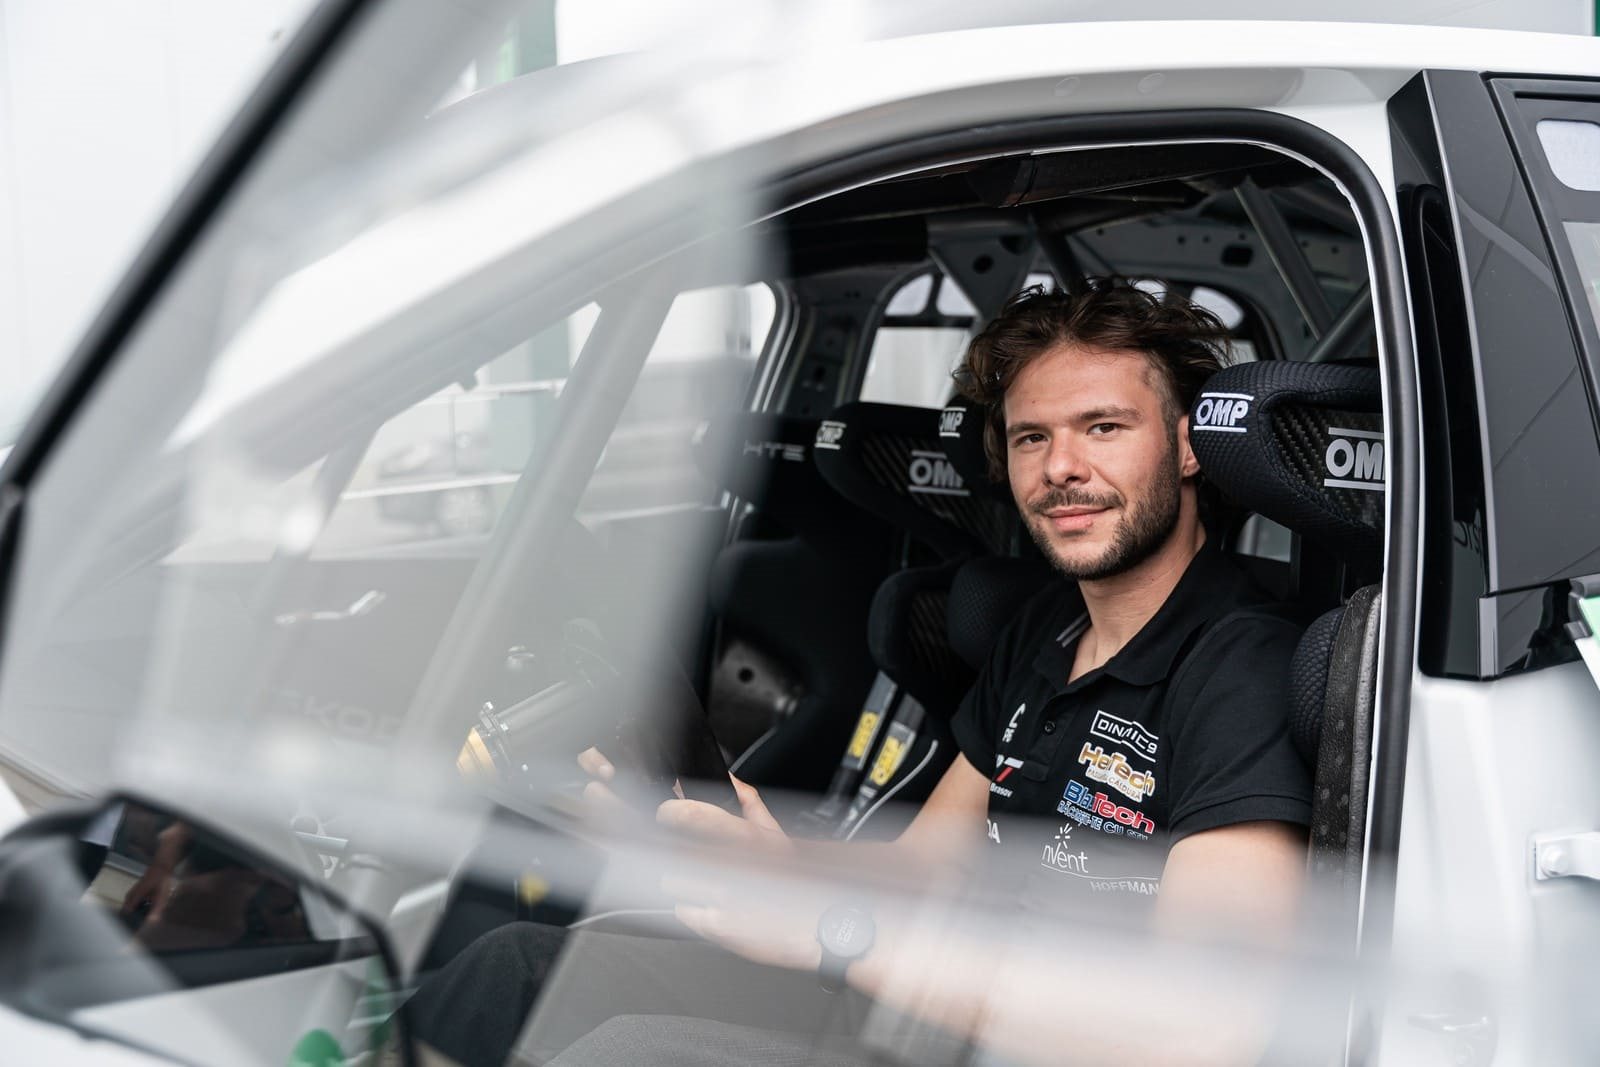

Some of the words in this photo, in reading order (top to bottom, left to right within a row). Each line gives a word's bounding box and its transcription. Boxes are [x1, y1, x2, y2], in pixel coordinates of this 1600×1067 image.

[1195, 399, 1249, 426] OMP
[1325, 439, 1385, 480] OM
[1090, 880, 1159, 895] HOFFMAN
